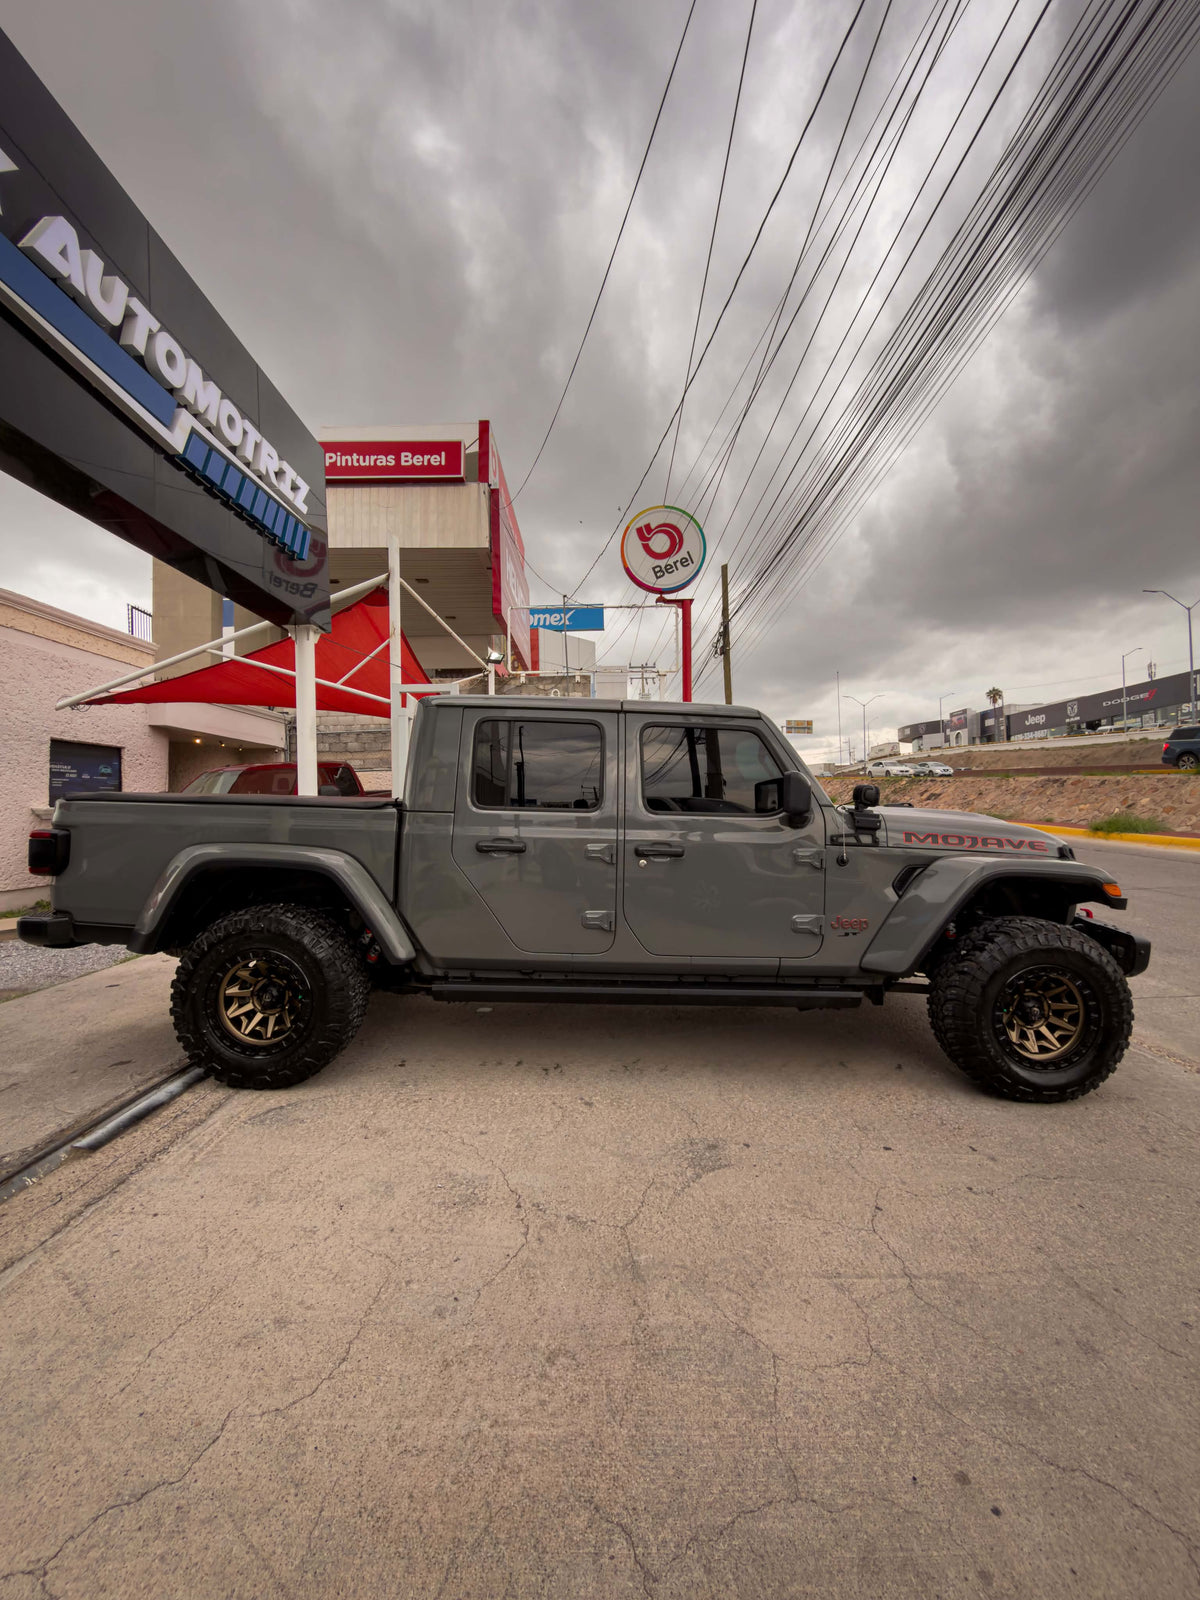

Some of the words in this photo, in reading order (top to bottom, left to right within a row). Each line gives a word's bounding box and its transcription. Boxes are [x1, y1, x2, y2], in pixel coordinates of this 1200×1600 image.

[18, 216, 310, 515] AUTOMOTRIZ
[325, 452, 396, 467] Pinturas
[400, 451, 446, 466] Berel
[652, 551, 694, 580] Berel
[1102, 692, 1149, 707] DODGE
[1025, 714, 1046, 726] Jeep
[903, 832, 1049, 852] MOJAVE
[831, 915, 869, 931] Jeep
